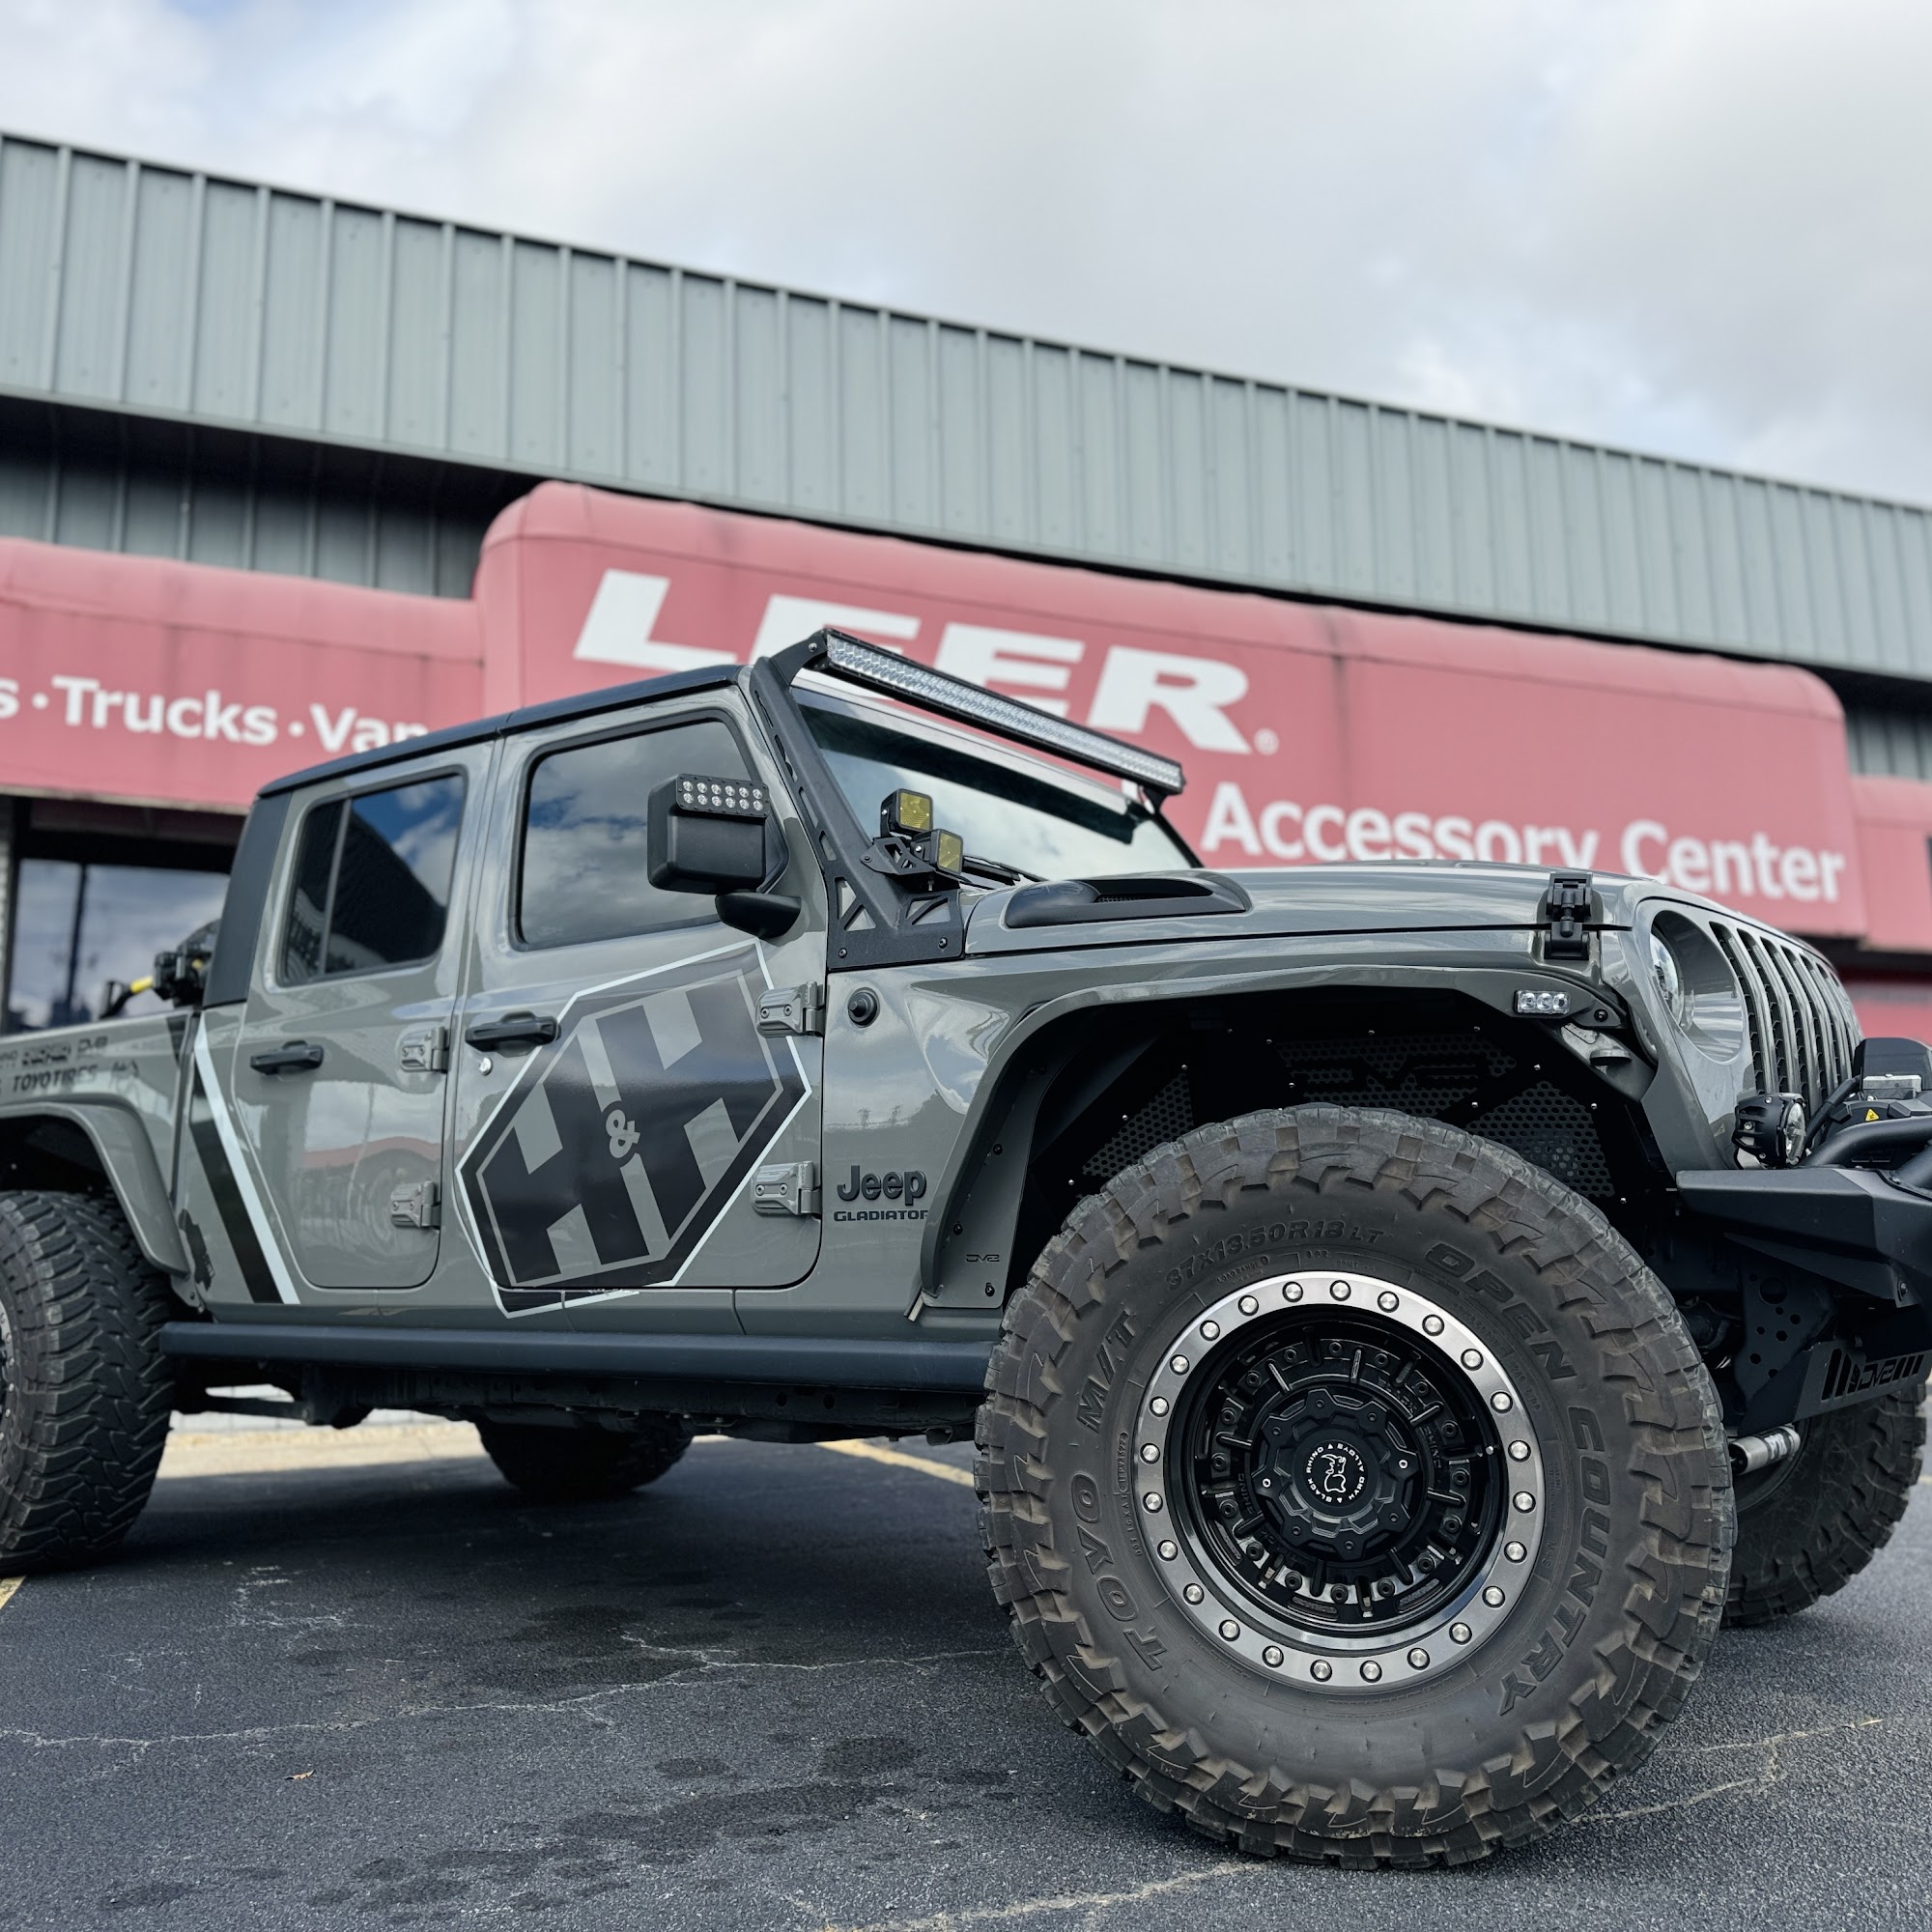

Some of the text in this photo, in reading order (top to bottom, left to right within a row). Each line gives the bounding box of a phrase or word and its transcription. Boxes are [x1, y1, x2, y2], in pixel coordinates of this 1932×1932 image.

[51, 673, 279, 748] Trucks
[1200, 782, 1845, 900] Accessory Center
[837, 1164, 927, 1207] Jeep
[1076, 1307, 1137, 1434] M/T
[1305, 1446, 1333, 1503] BLACK RHINO
[1425, 1242, 1610, 1717] OPEN COUNTRY
[1069, 1473, 1167, 1673] TOYO
